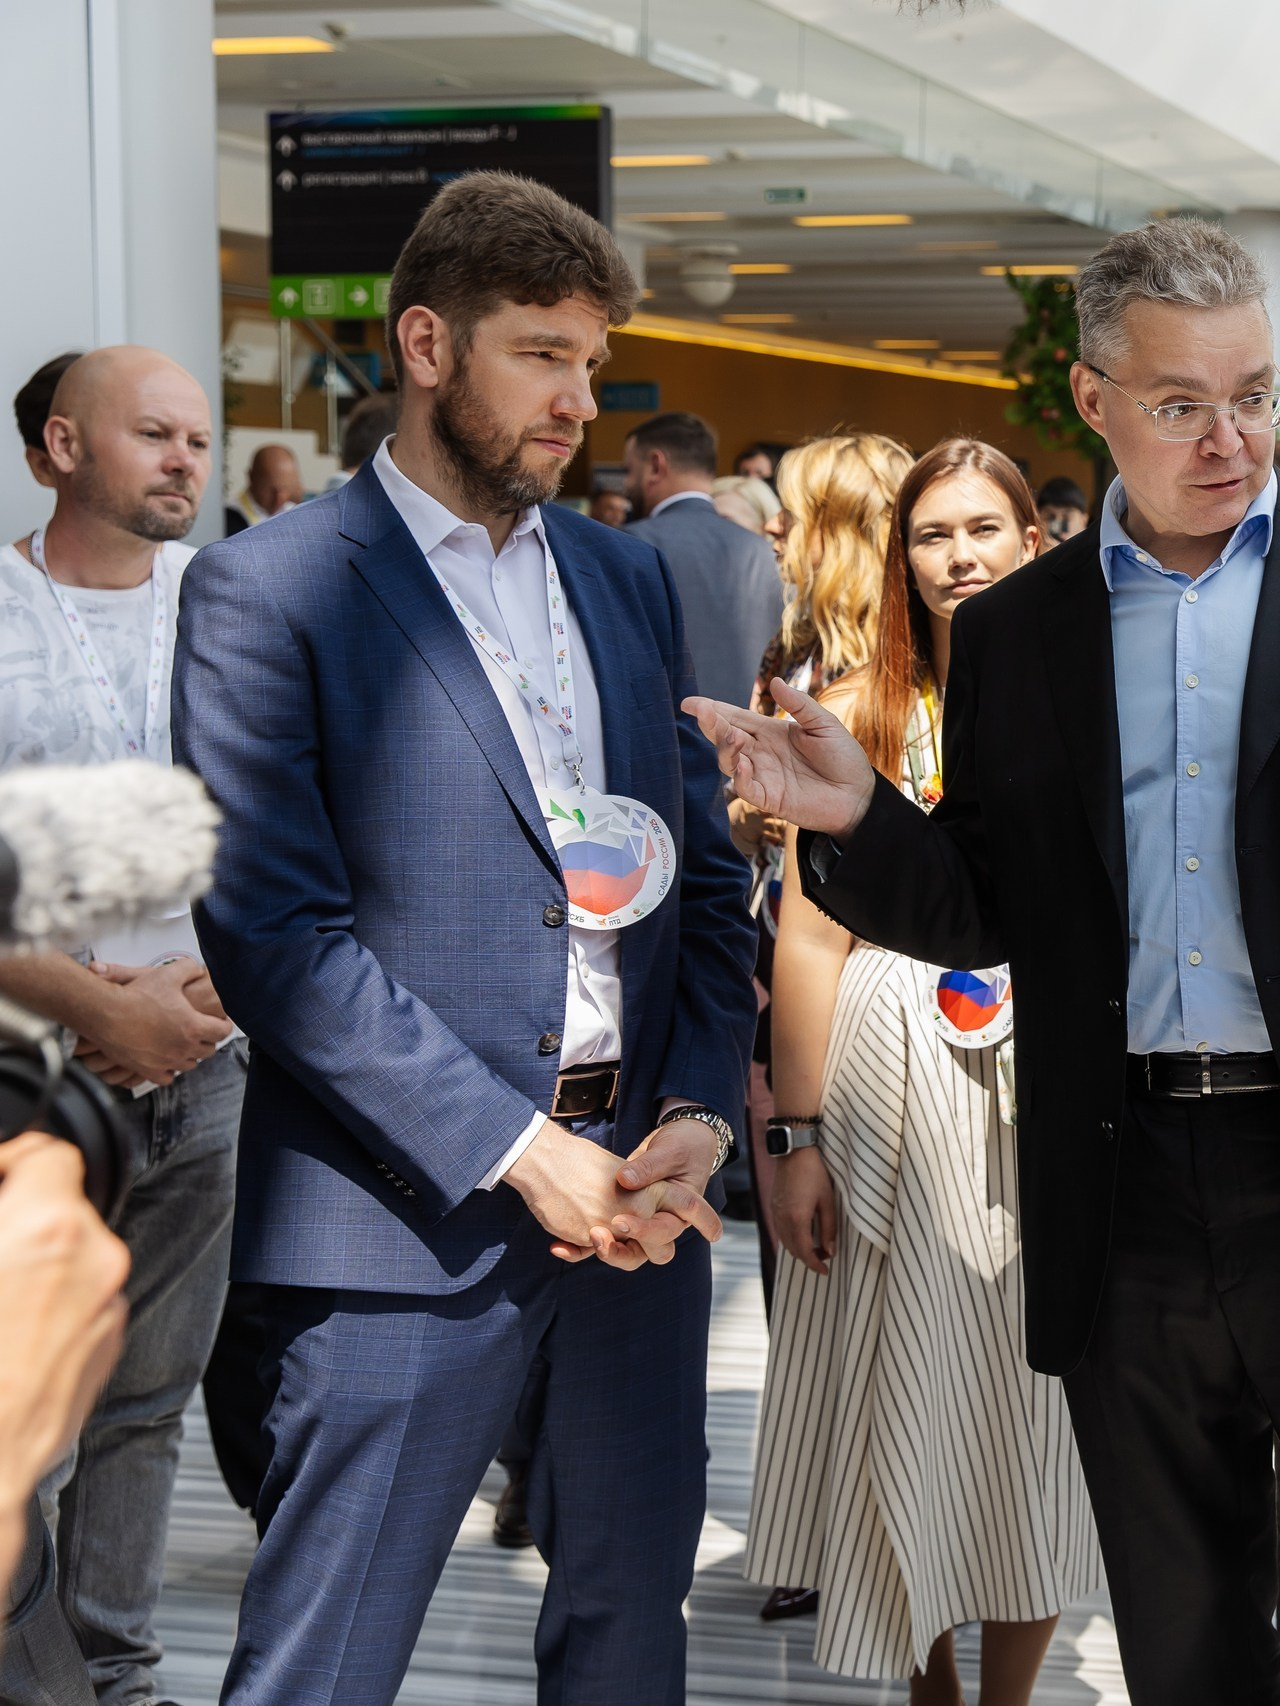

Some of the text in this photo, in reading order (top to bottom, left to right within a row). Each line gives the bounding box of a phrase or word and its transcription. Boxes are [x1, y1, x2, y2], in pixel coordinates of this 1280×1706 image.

[649, 818, 669, 896] САДЫ РОССИИ 2025
